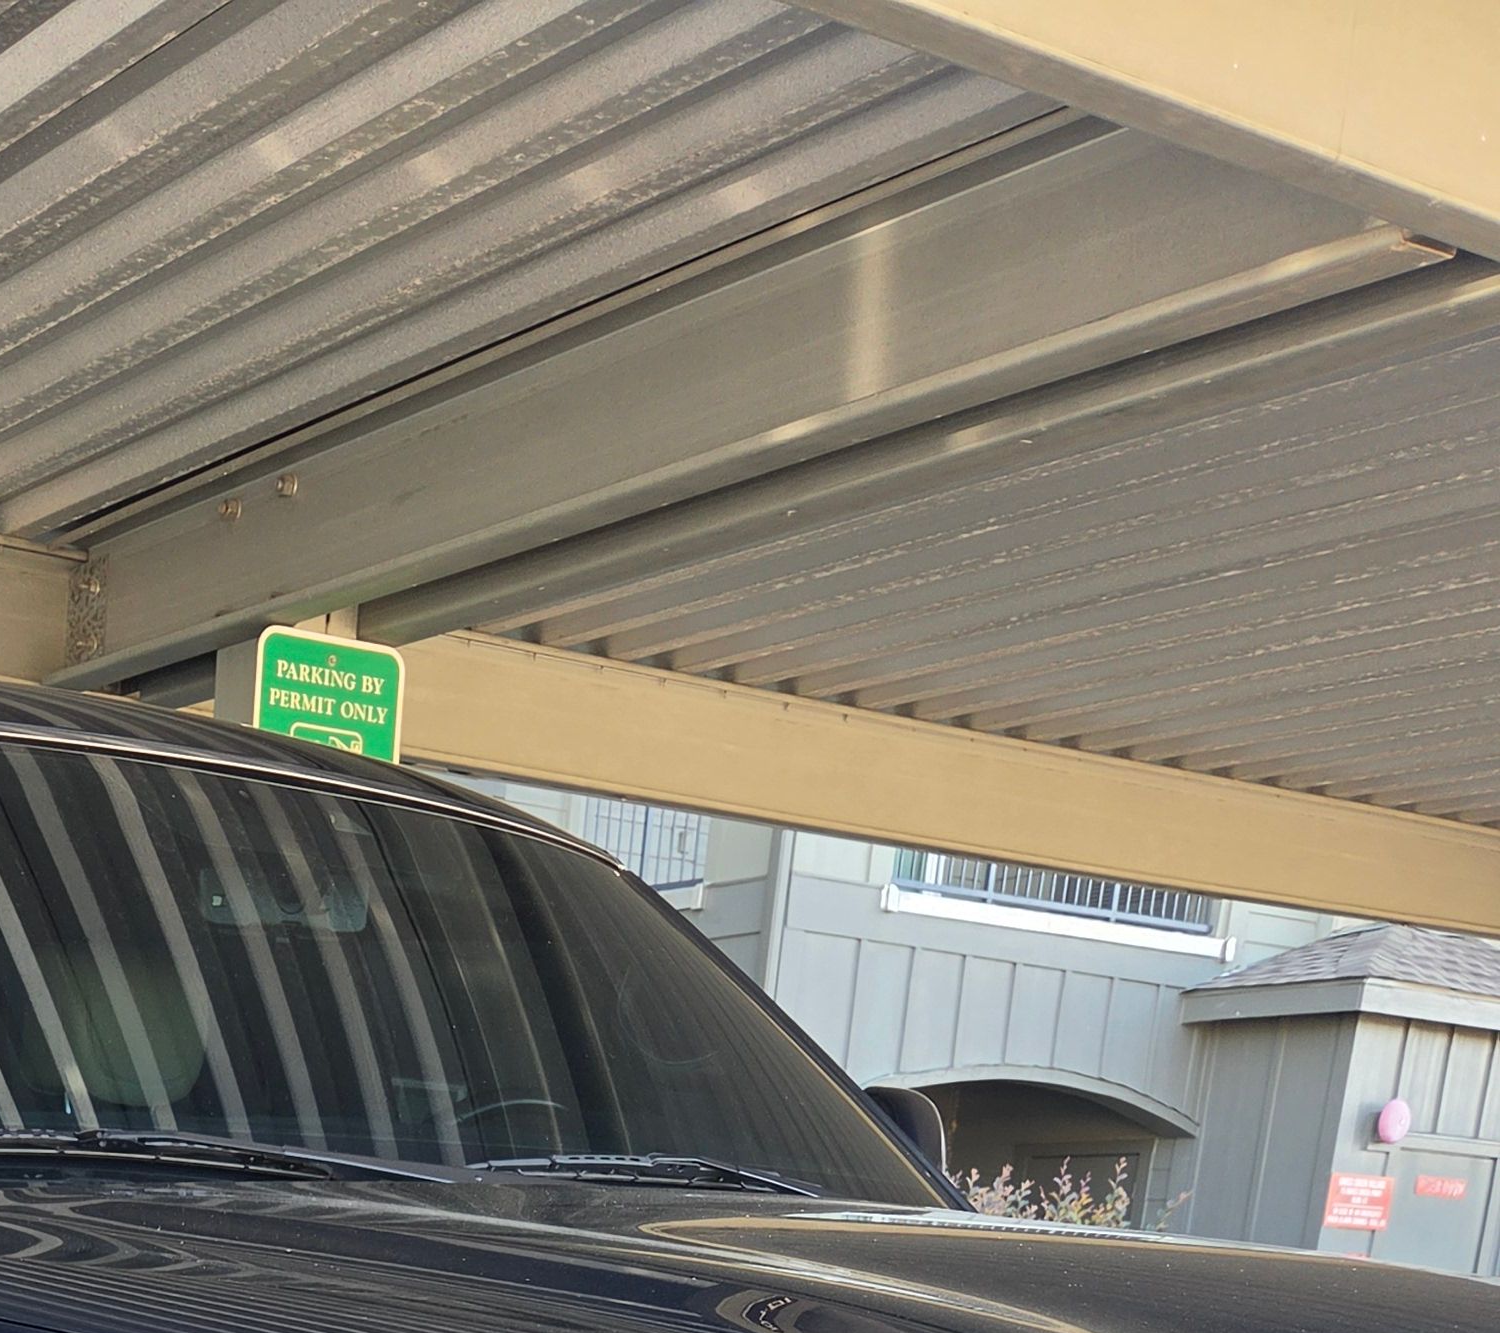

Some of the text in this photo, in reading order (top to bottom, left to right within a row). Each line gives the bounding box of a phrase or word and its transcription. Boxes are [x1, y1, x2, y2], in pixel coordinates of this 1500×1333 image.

[277, 660, 385, 695] PARKING BY
[269, 687, 388, 724] PERMIT ONLY
